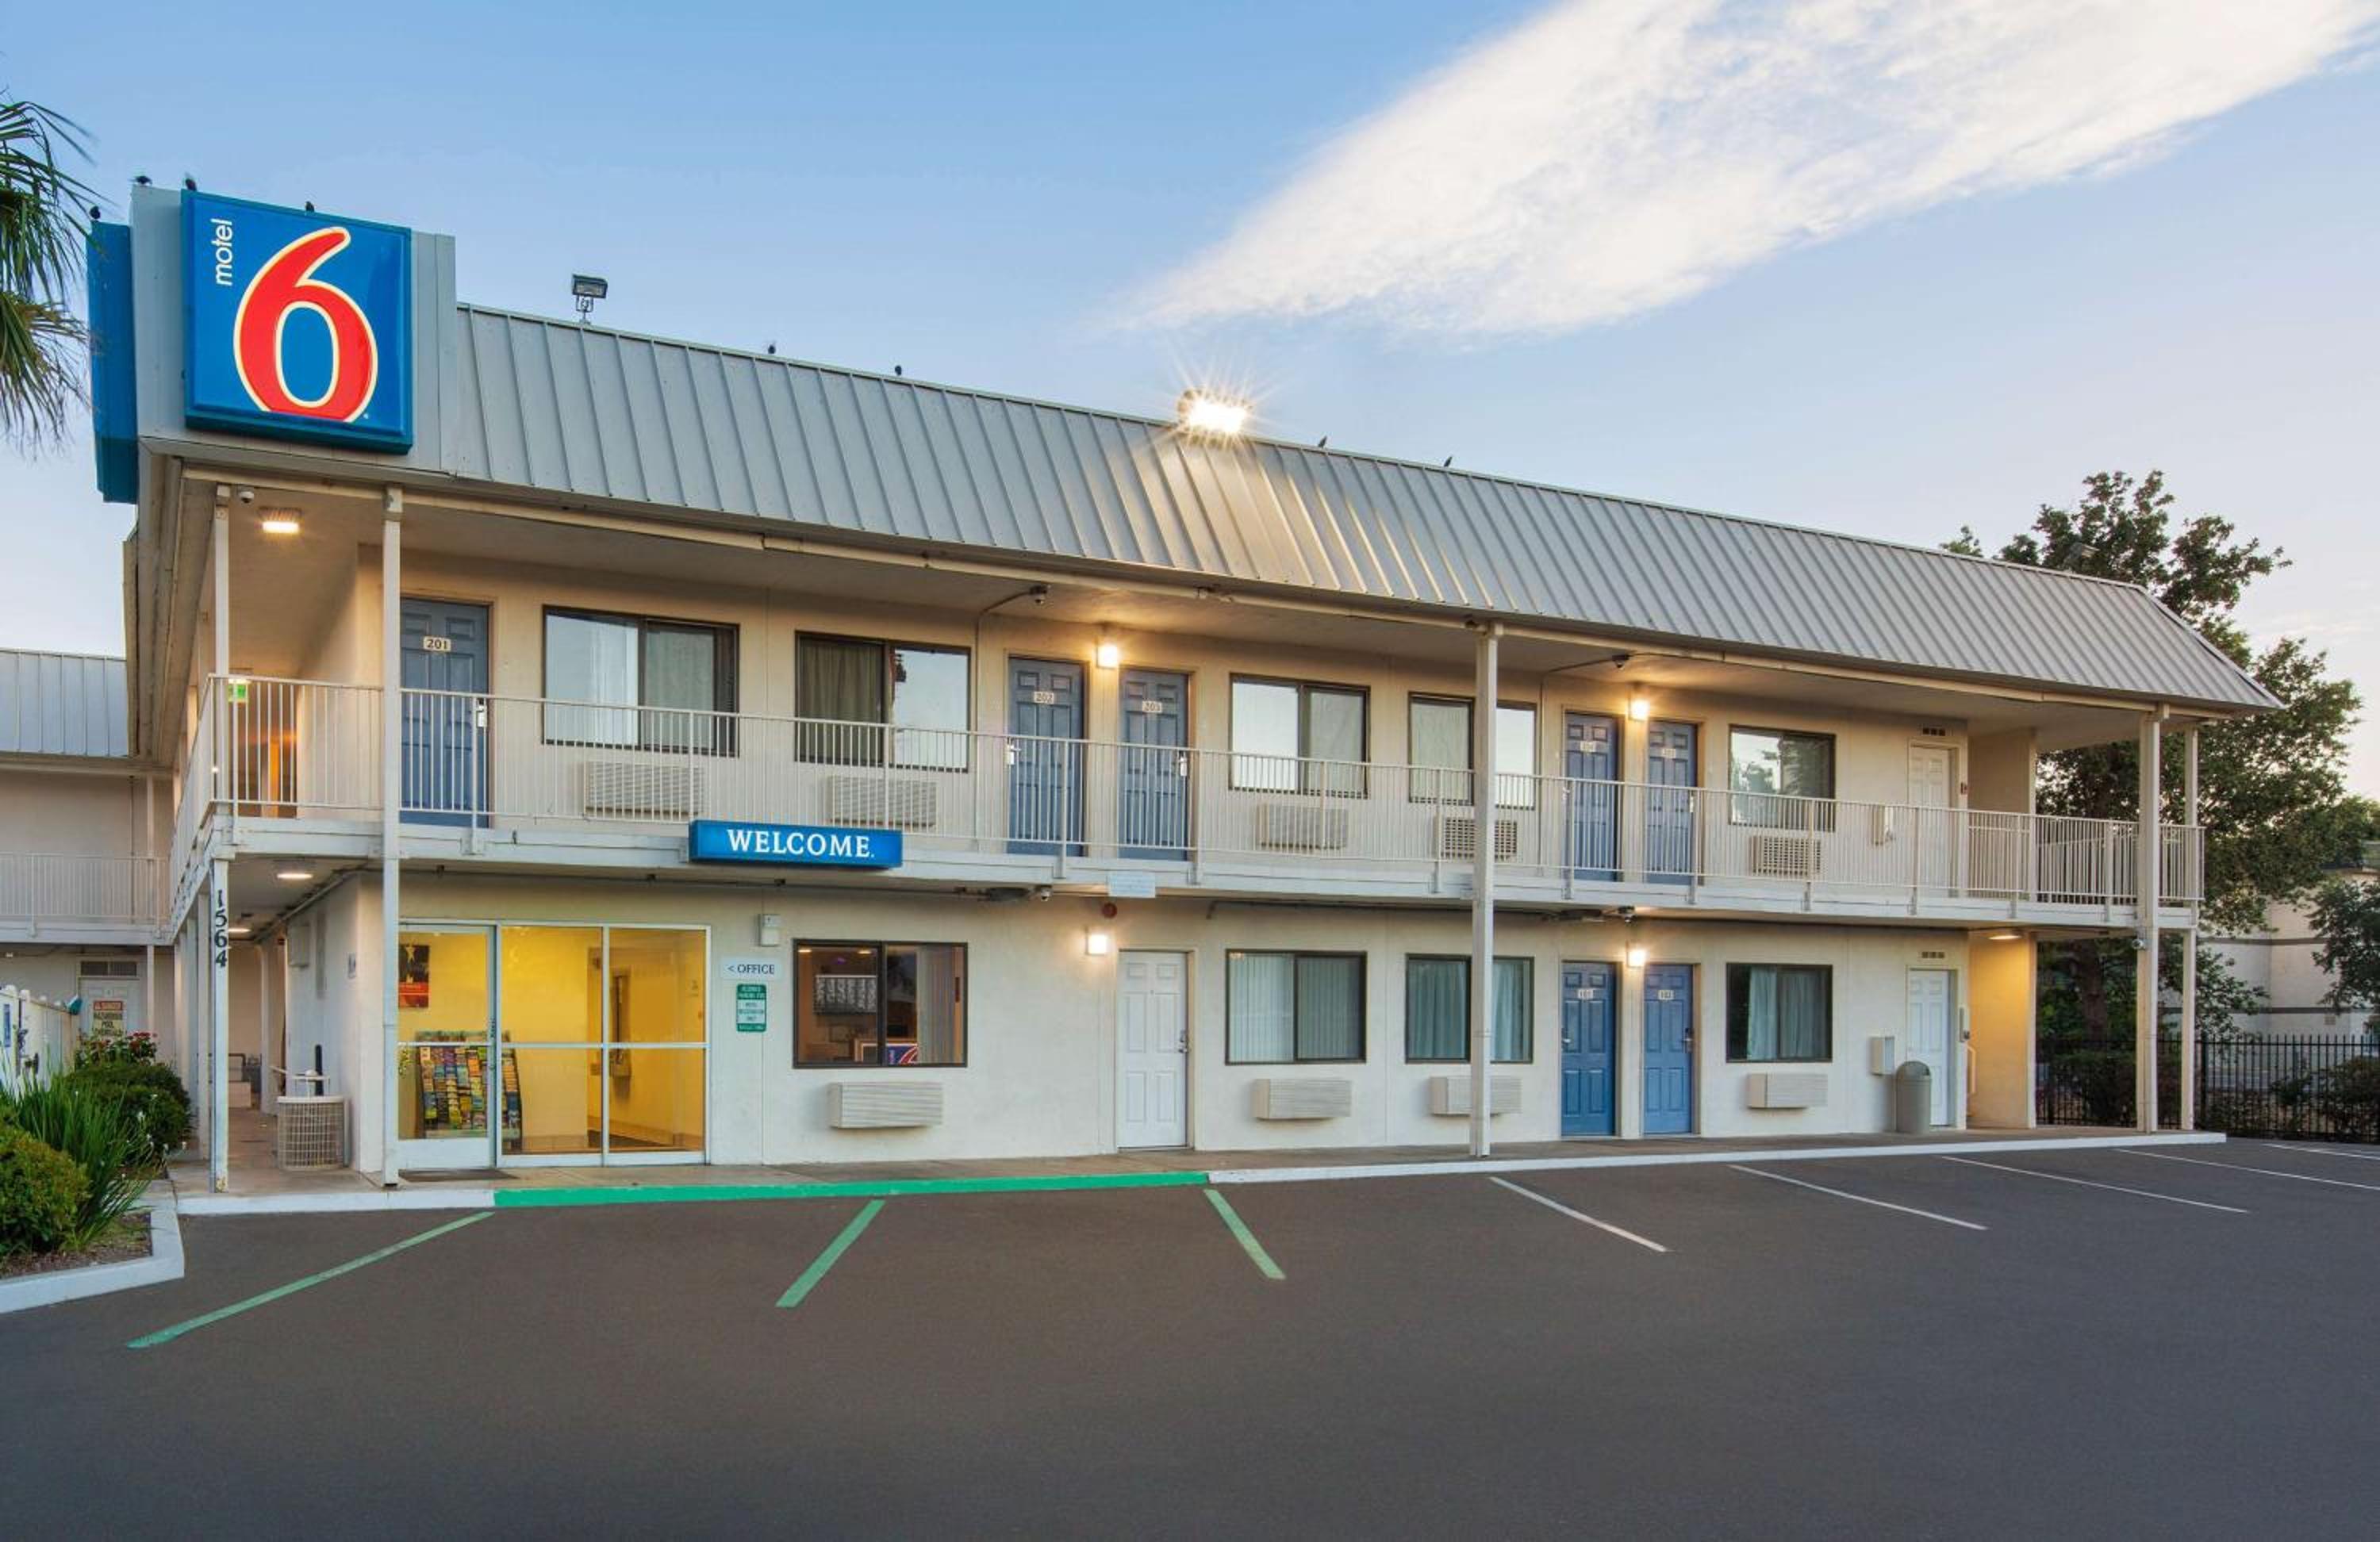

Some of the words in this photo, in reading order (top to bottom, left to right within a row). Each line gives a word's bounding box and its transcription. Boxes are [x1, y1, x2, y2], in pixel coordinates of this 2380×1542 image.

[210, 218, 233, 286] motel
[233, 226, 378, 423] 6
[426, 639, 447, 650] 201
[214, 889, 228, 968] 1564
[737, 964, 775, 975] OFFICE
